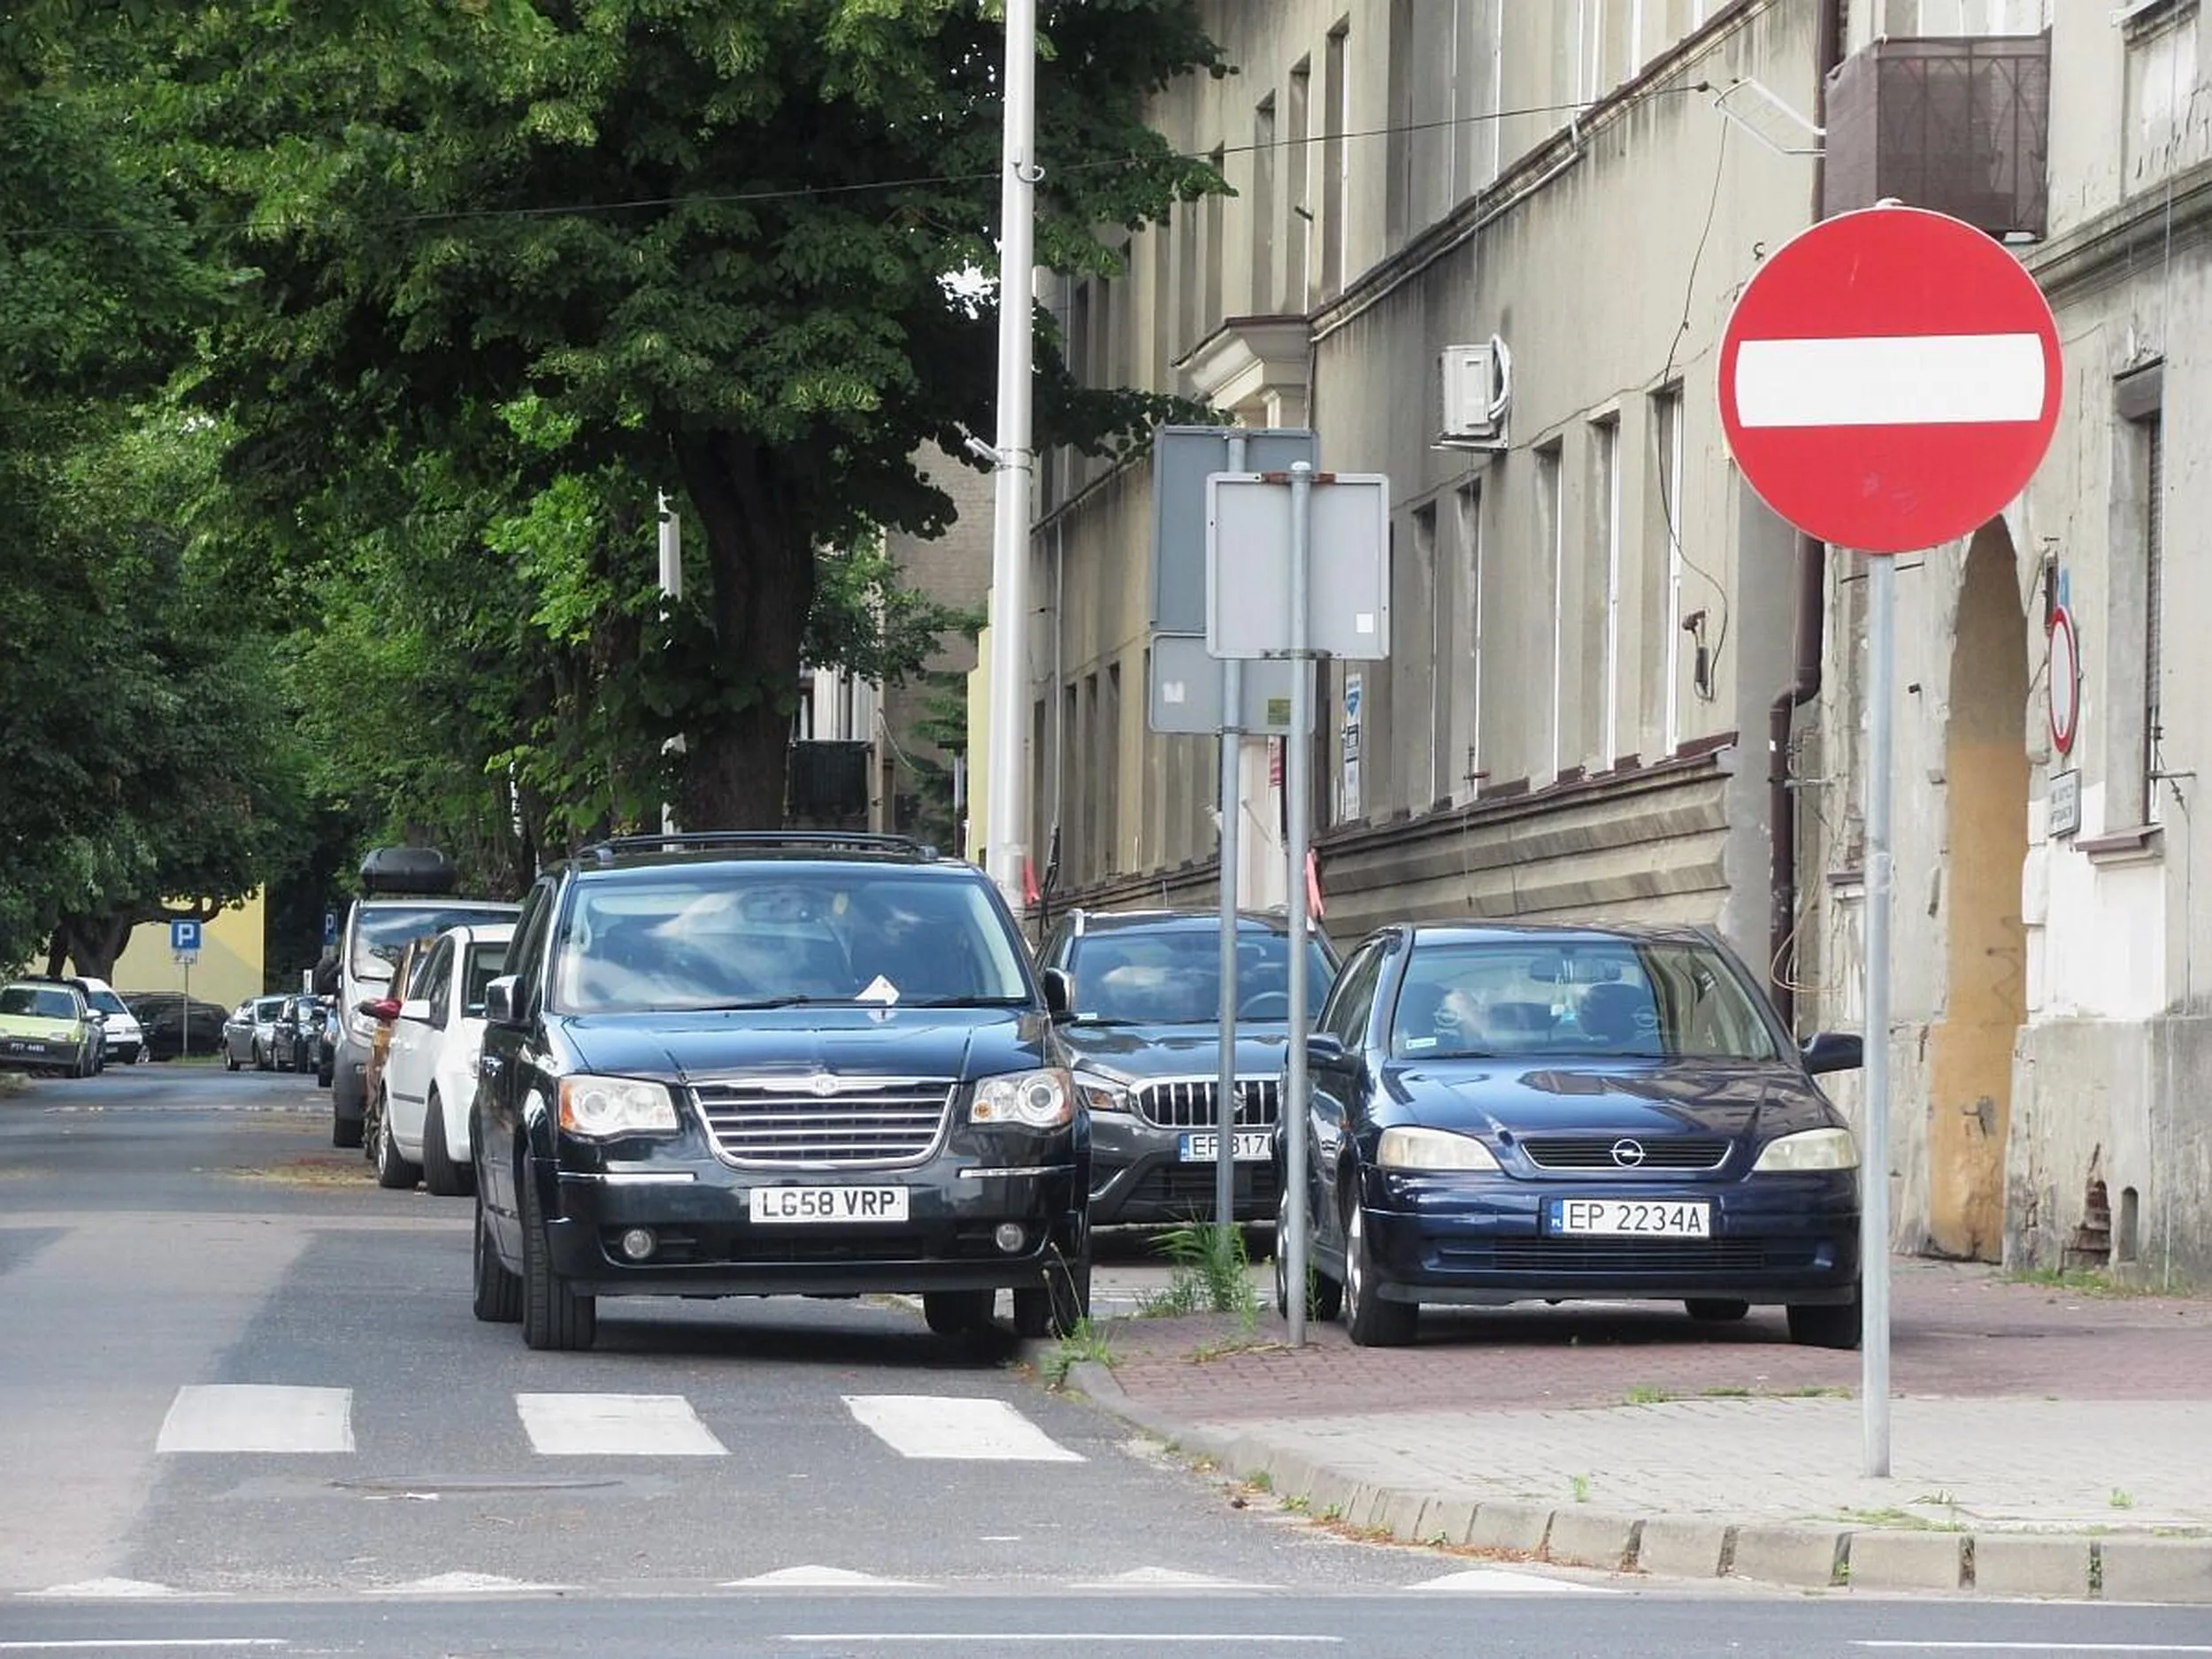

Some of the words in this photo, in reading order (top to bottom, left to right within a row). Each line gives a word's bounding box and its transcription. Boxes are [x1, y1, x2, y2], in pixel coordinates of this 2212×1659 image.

[178, 923, 195, 946] P
[762, 1191, 834, 1217] LG58
[844, 1190, 895, 1216] VRP
[1569, 1202, 1605, 1230] EP
[1617, 1204, 1701, 1233] 2234A
